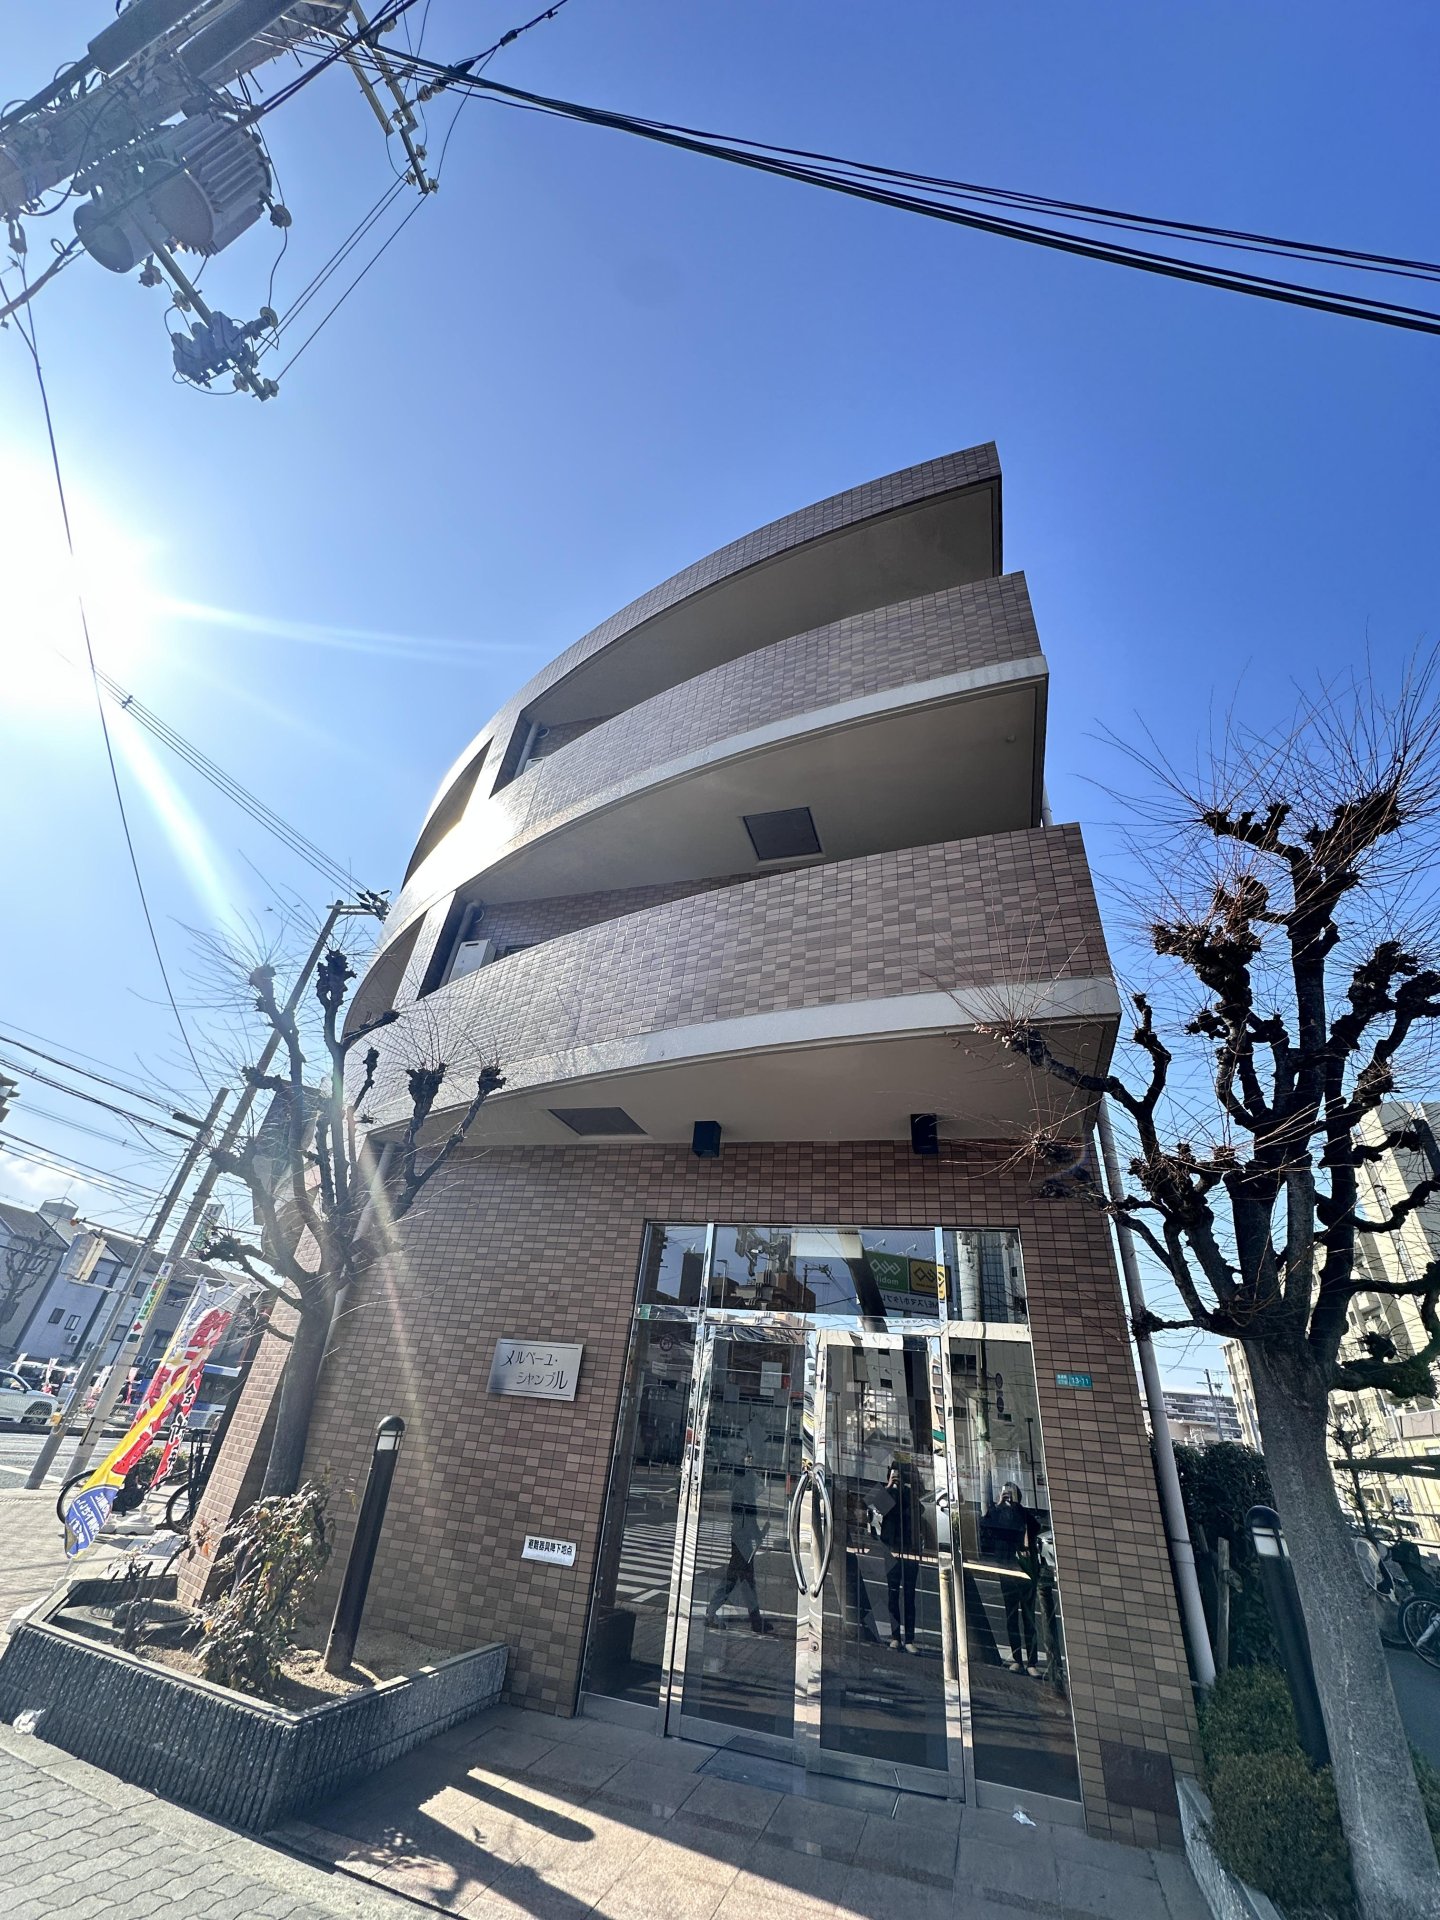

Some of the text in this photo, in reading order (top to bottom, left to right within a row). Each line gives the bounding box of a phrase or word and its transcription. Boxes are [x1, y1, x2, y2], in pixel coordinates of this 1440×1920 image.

[516, 1370, 569, 1390] シャンブル
[1071, 1377, 1089, 1385] 13-11
[528, 1539, 573, 1555] 避難器具降下地点
